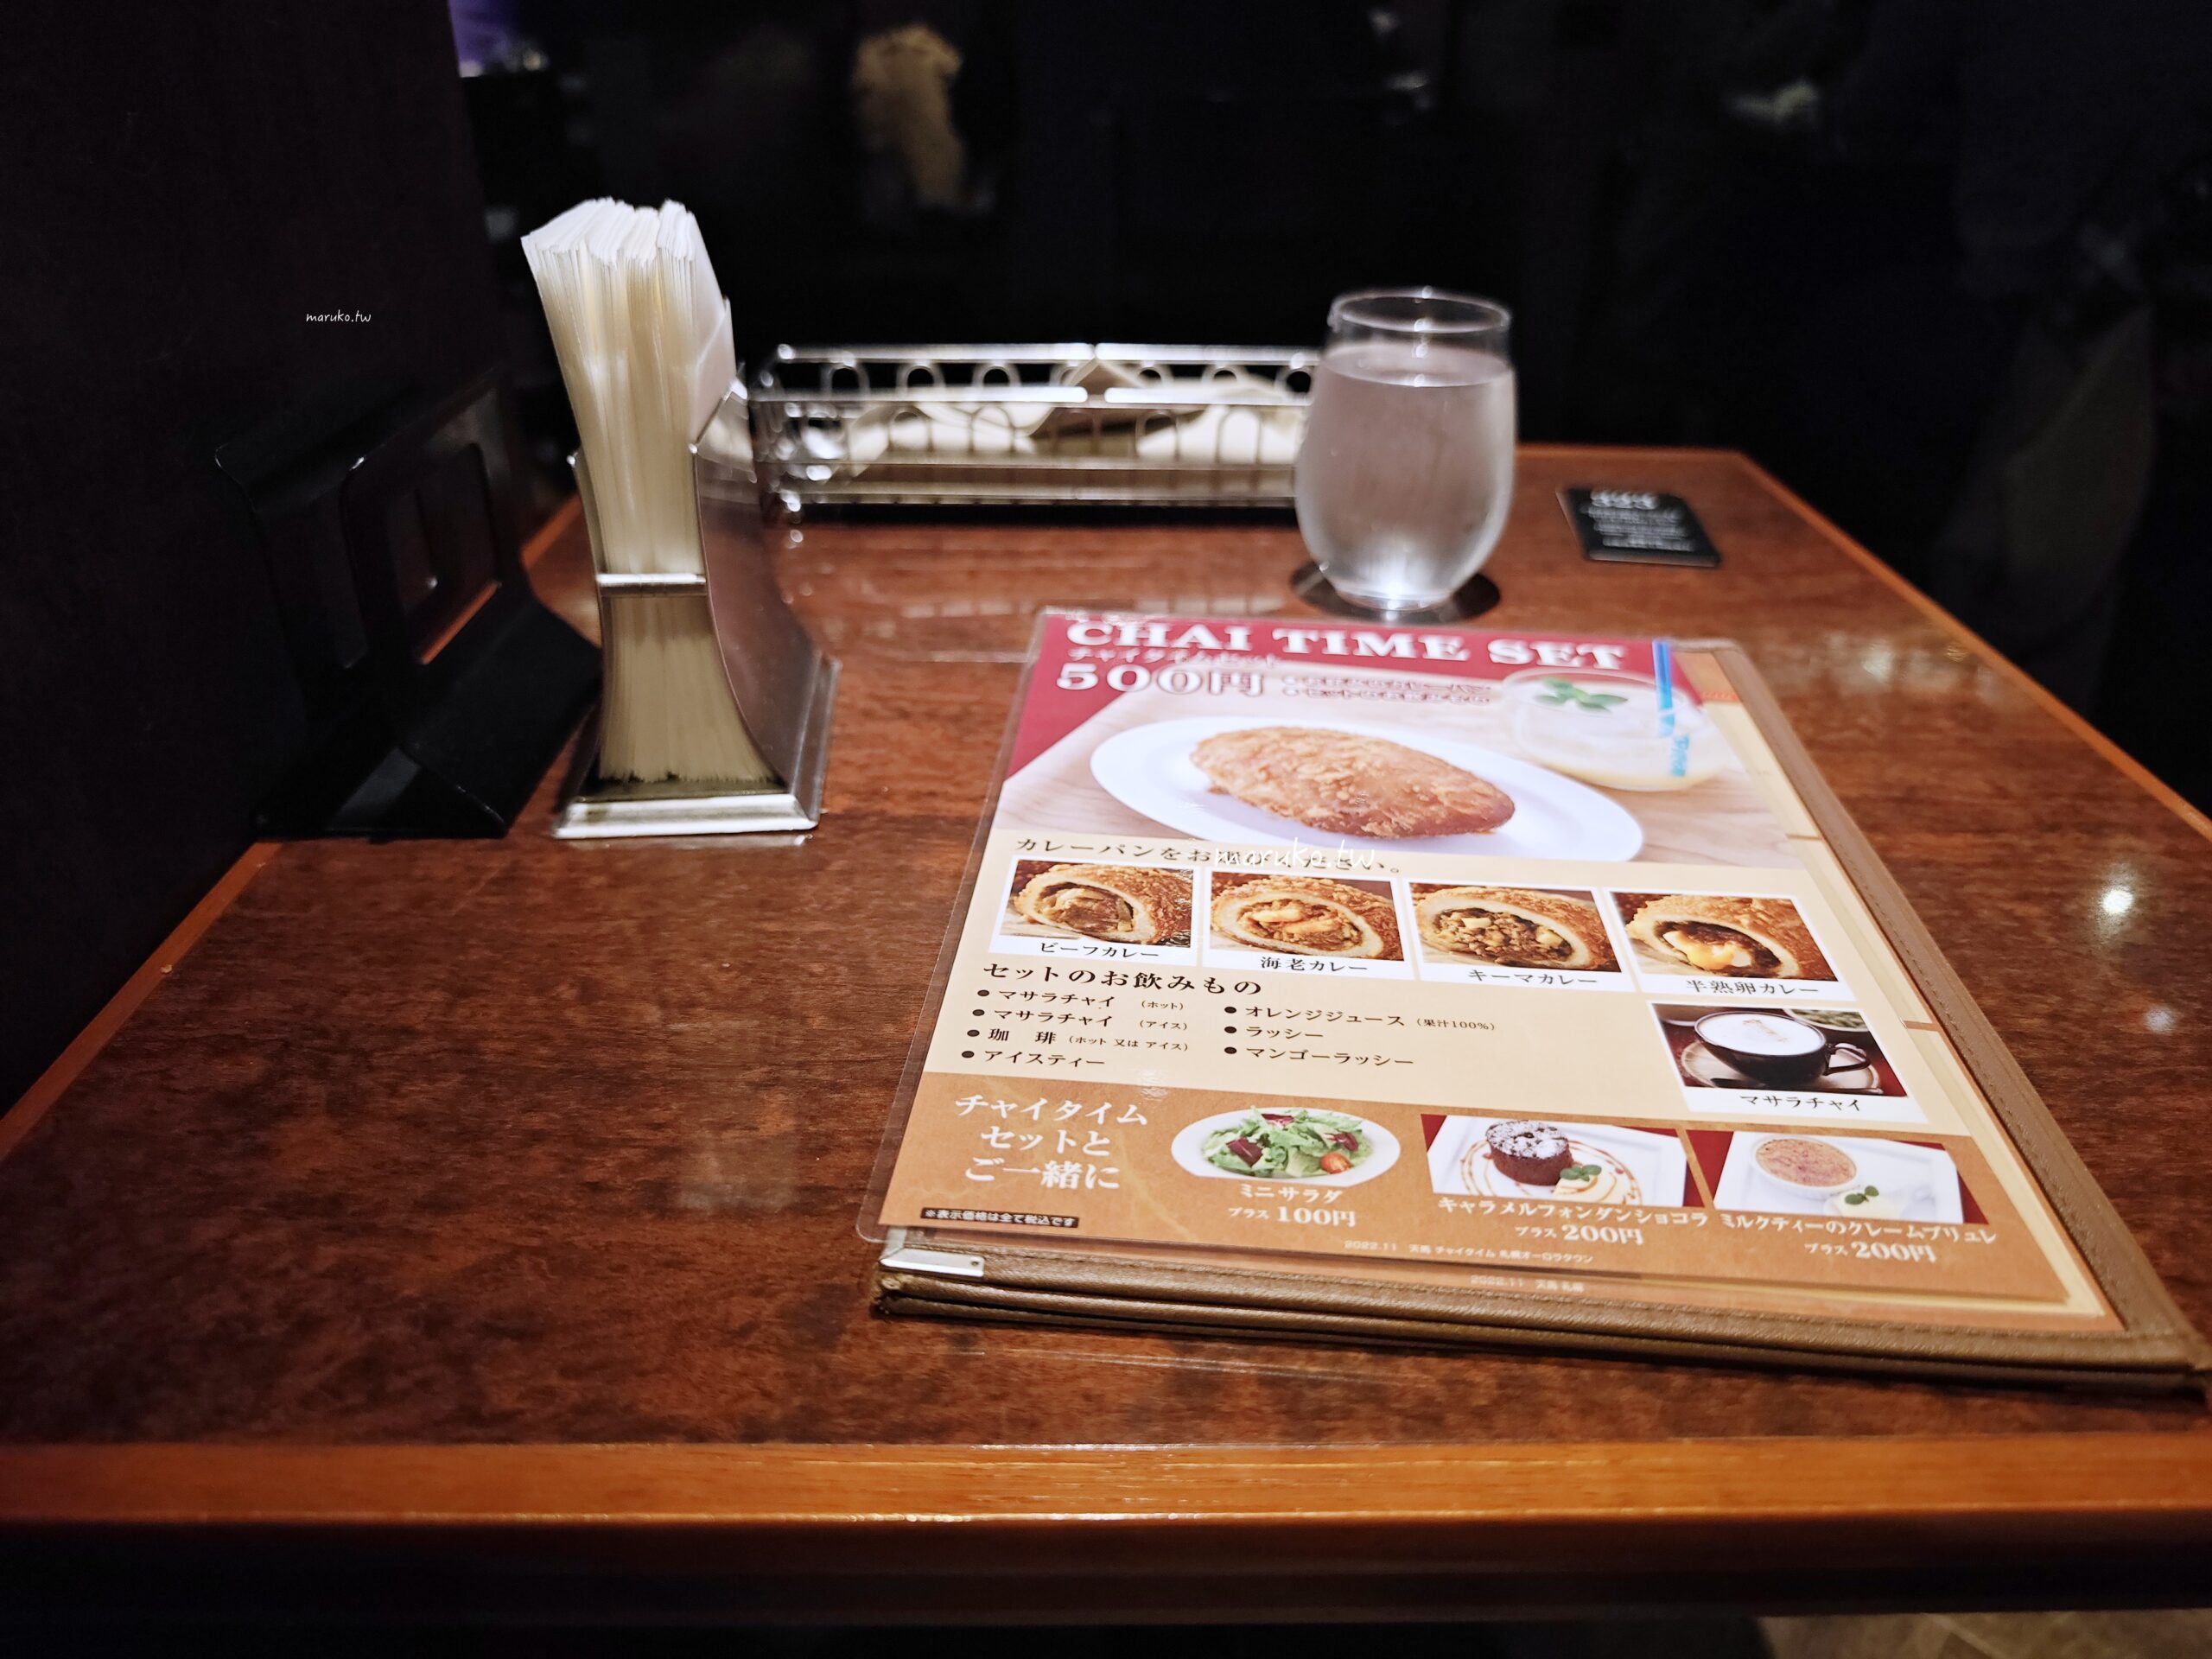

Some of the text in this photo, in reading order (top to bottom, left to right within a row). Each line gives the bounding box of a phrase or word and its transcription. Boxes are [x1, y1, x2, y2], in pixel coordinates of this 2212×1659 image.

[1066, 620, 1626, 671] CHAI TIME SET
[1056, 663, 1265, 696] 500円
[1039, 942, 1160, 959] ビーフカレー
[1260, 956, 1368, 973] 海老カレー
[983, 963, 1262, 995] セットのお飲みもの
[1467, 969, 1598, 987] キーマカレー
[1686, 978, 1818, 996] 半熟卵カレー
[999, 989, 1115, 1007] マサラチャイ
[995, 1009, 1113, 1027] マサラチャイ
[1246, 1006, 1405, 1027] オレンジジュース
[1246, 1026, 1324, 1039] ラッシー
[985, 1050, 1105, 1067] アイスティー
[1246, 1047, 1414, 1066] マンゴーラッシー
[955, 1093, 1147, 1126] チャイタイム
[1740, 1093, 1860, 1112] マサラチャイ
[980, 1126, 1110, 1156] セットと
[964, 1156, 1121, 1191] ご一緒に
[1240, 1183, 1344, 1205] ミニサラダ
[1228, 1206, 1357, 1227] プラス 100円
[1438, 1196, 1707, 1228] キャラメルフォンダンショコラ
[1515, 1224, 1643, 1245] プラス 200円
[1719, 1212, 1997, 1244] ミルクティーのクレームブリュレ
[1804, 1241, 1937, 1263] プラス 200円
